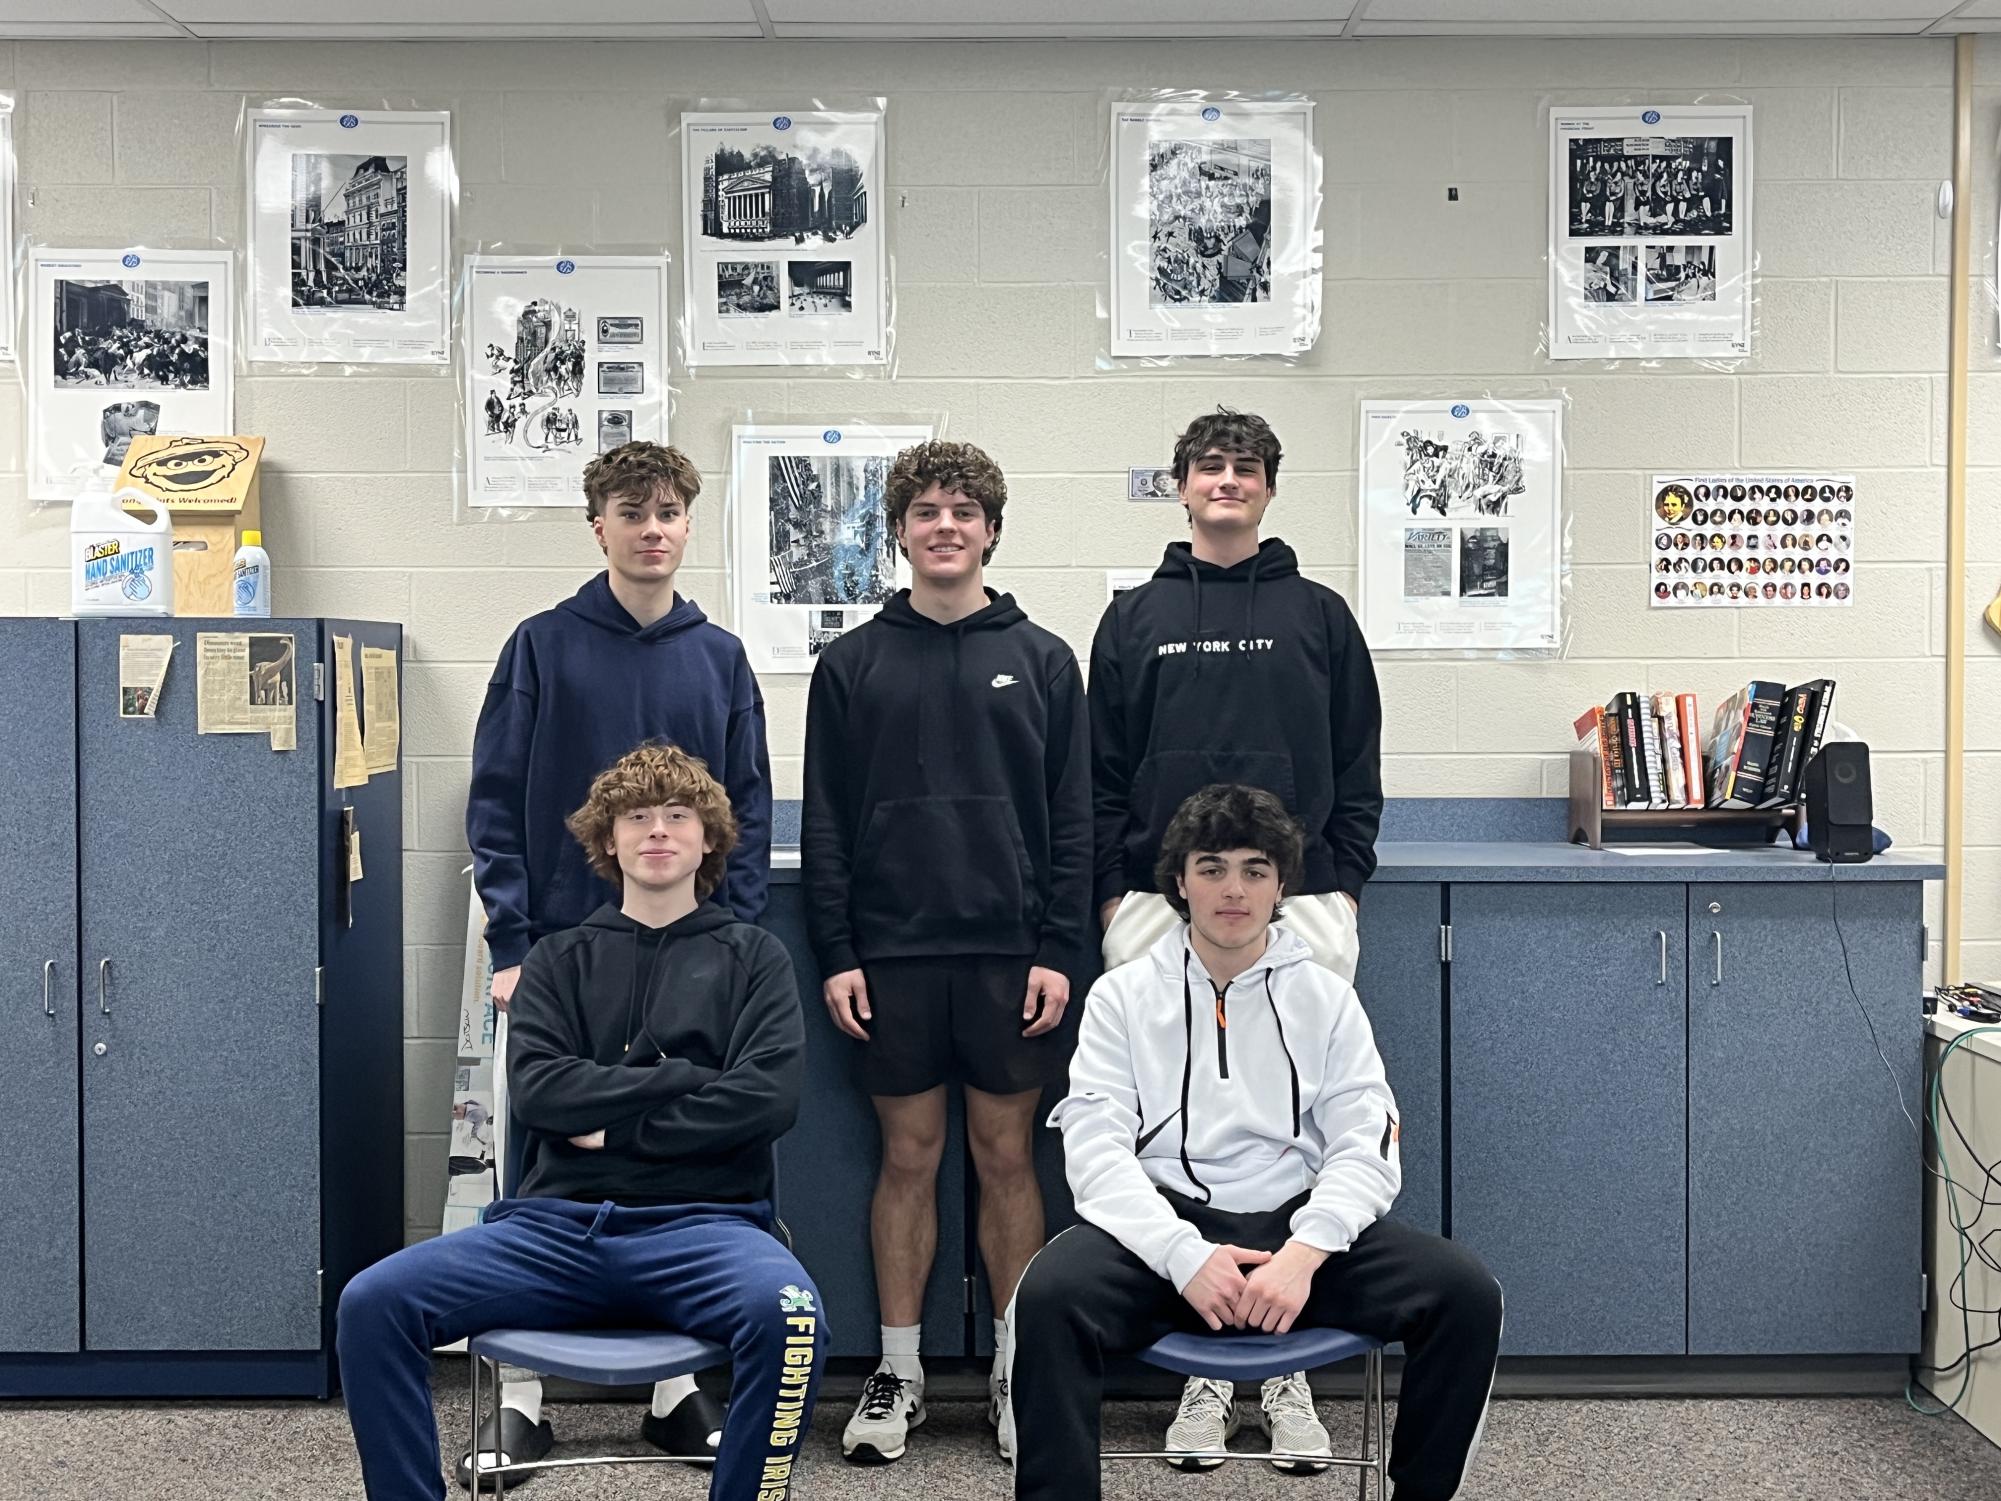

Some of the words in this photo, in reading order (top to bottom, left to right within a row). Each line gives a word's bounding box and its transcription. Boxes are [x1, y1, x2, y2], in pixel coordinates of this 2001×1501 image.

[178, 496, 238, 504] Welcomed!
[85, 540, 120, 562] BLASTER
[85, 558, 108, 581] HAND
[109, 546, 154, 576] SANITIZER
[1158, 643, 1187, 656] NEW
[1193, 641, 1230, 652] YORK
[1239, 639, 1274, 651] CITY
[770, 1317, 815, 1447] FIGHTING
[757, 1454, 793, 1501] IRIS
